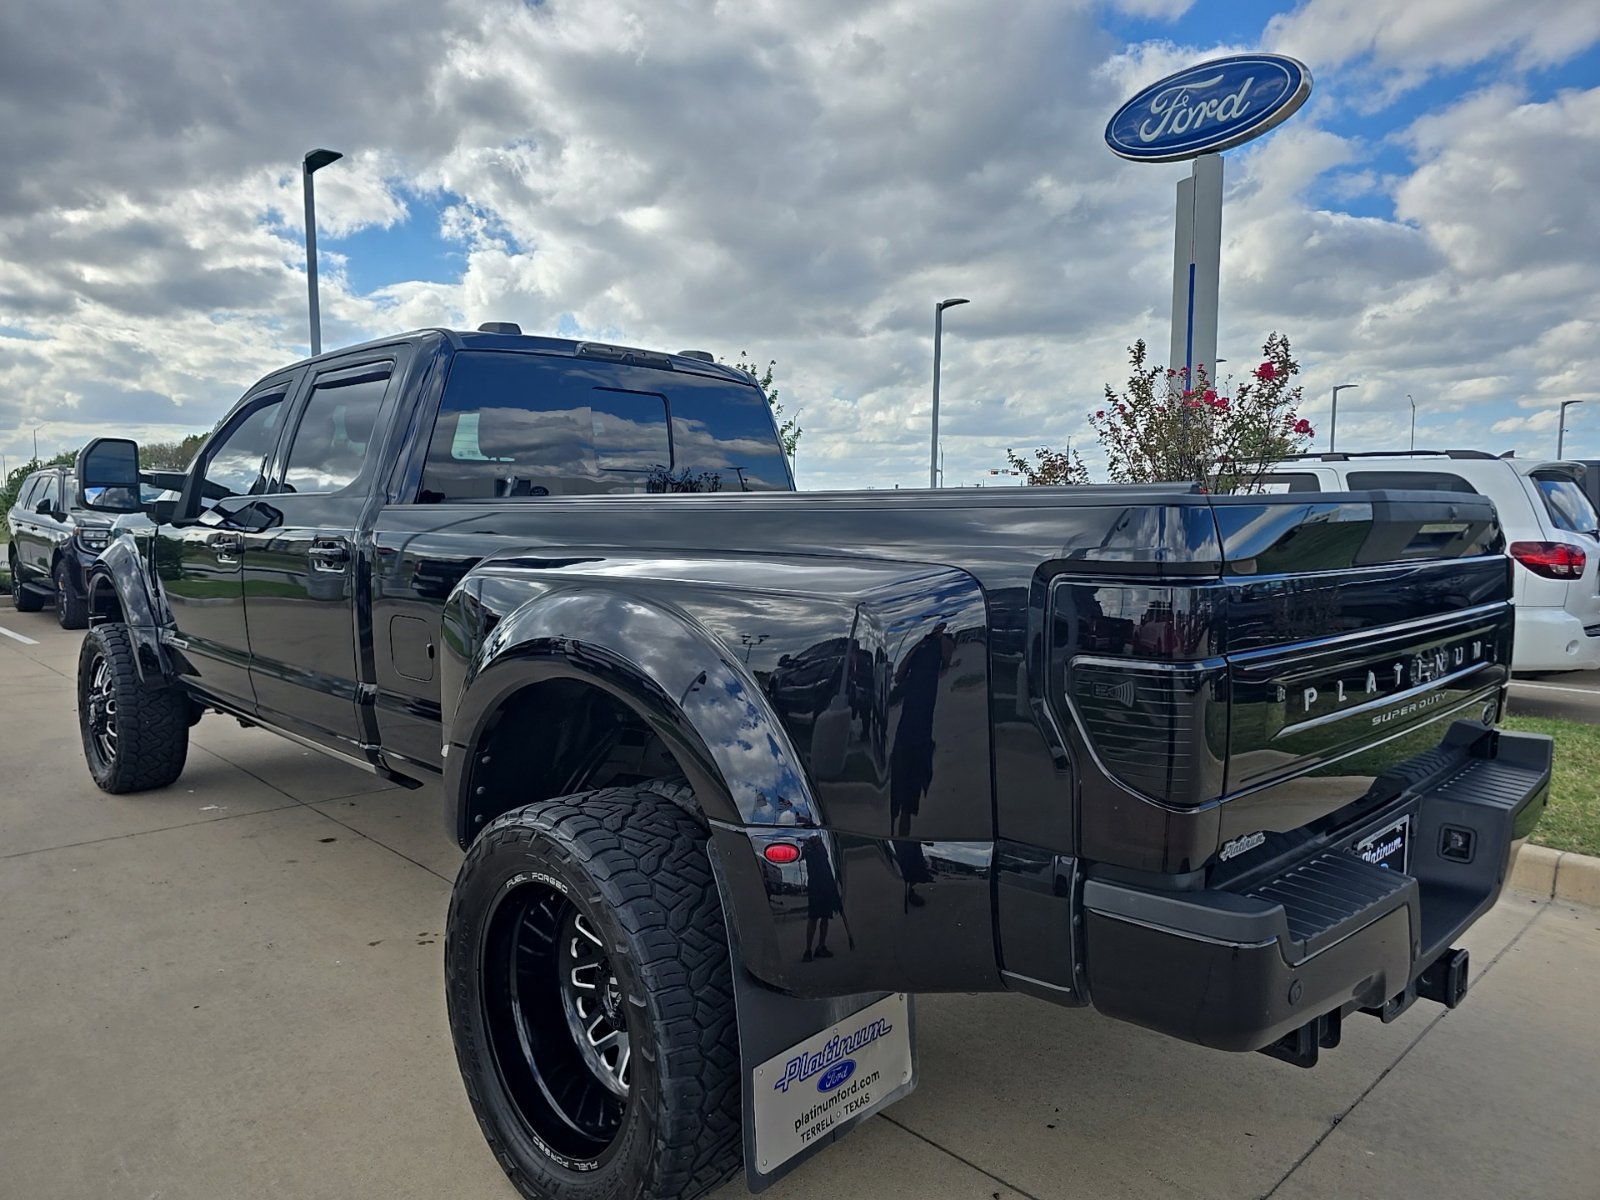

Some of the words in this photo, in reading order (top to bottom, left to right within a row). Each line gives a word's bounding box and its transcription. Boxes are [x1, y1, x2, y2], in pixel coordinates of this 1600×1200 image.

[1139, 74, 1255, 142] Ford
[1303, 640, 1482, 713] PLATINUM
[1371, 703, 1417, 727] SUPER
[1419, 691, 1448, 709] DUTY
[505, 873, 528, 889] FUEL
[531, 872, 569, 894] FORGED
[773, 1018, 893, 1094] Platinum
[824, 1067, 849, 1088] Ford
[793, 1070, 881, 1134] platinumford.com
[800, 1115, 835, 1144] TERRELL
[843, 1092, 871, 1116] TEXAS
